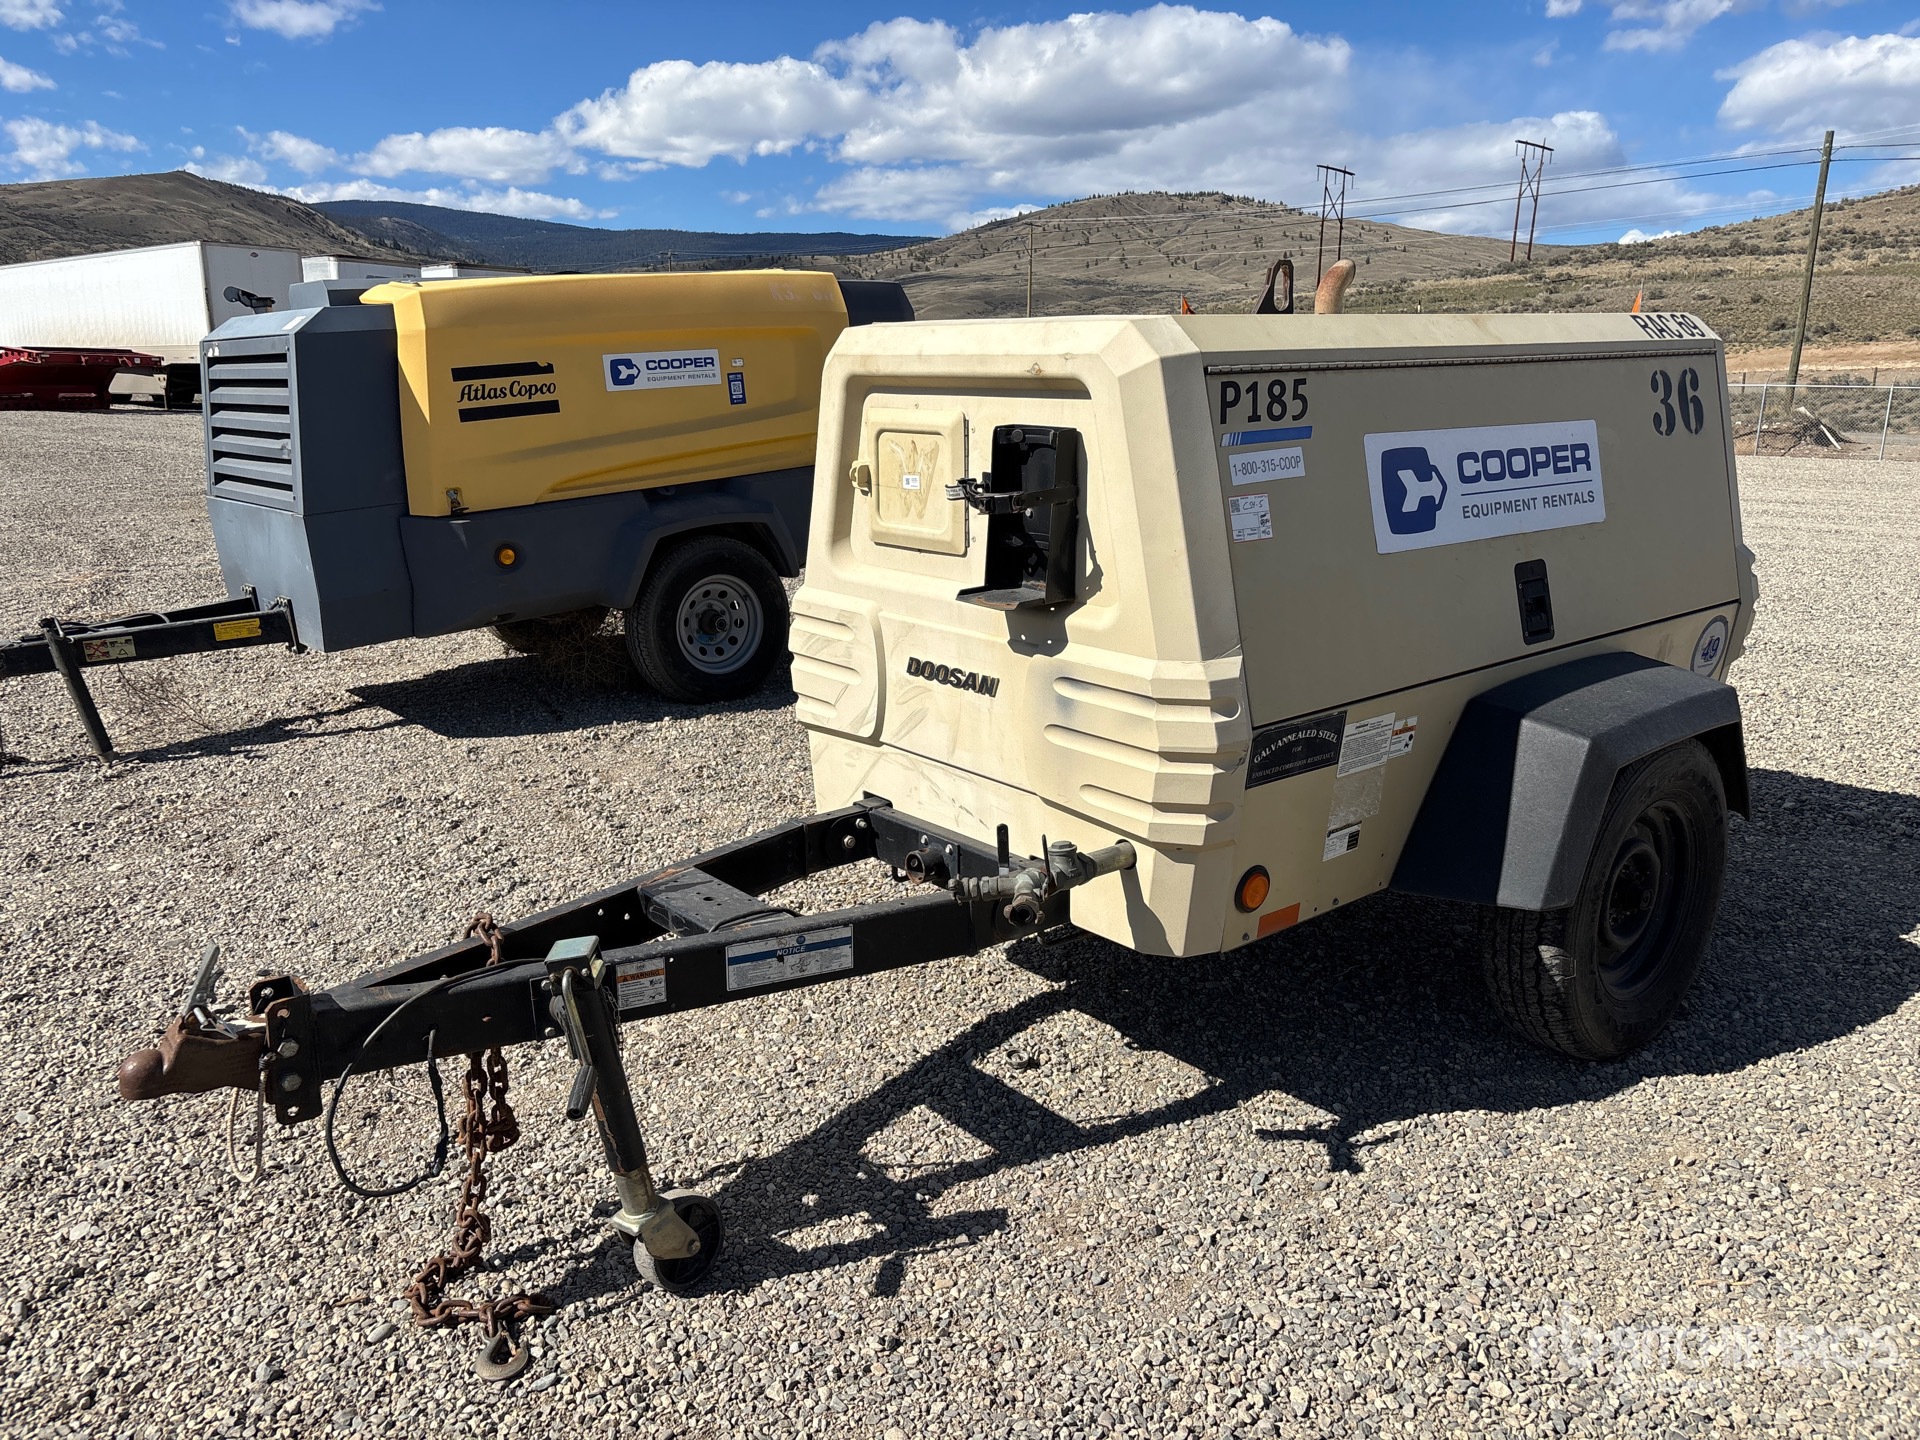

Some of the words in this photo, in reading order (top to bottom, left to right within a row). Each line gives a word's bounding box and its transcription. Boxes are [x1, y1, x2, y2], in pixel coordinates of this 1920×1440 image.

[645, 357, 715, 371] COOPER
[646, 374, 687, 382] EQUIPMENT
[687, 372, 717, 380] RENTALS
[457, 383, 508, 403] Atlas
[509, 380, 557, 397] Copco
[1220, 378, 1308, 425] P185
[1650, 367, 1704, 436] 36
[1232, 455, 1302, 477] 1-800-315-COOP
[1456, 442, 1592, 485] COOPER
[1461, 497, 1538, 519] EQUIPMENT
[1543, 490, 1596, 510] RENTALS
[906, 656, 1001, 699] DOOSAN
[1317, 729, 1338, 744] STEEL
[776, 945, 806, 957] NOTICE
